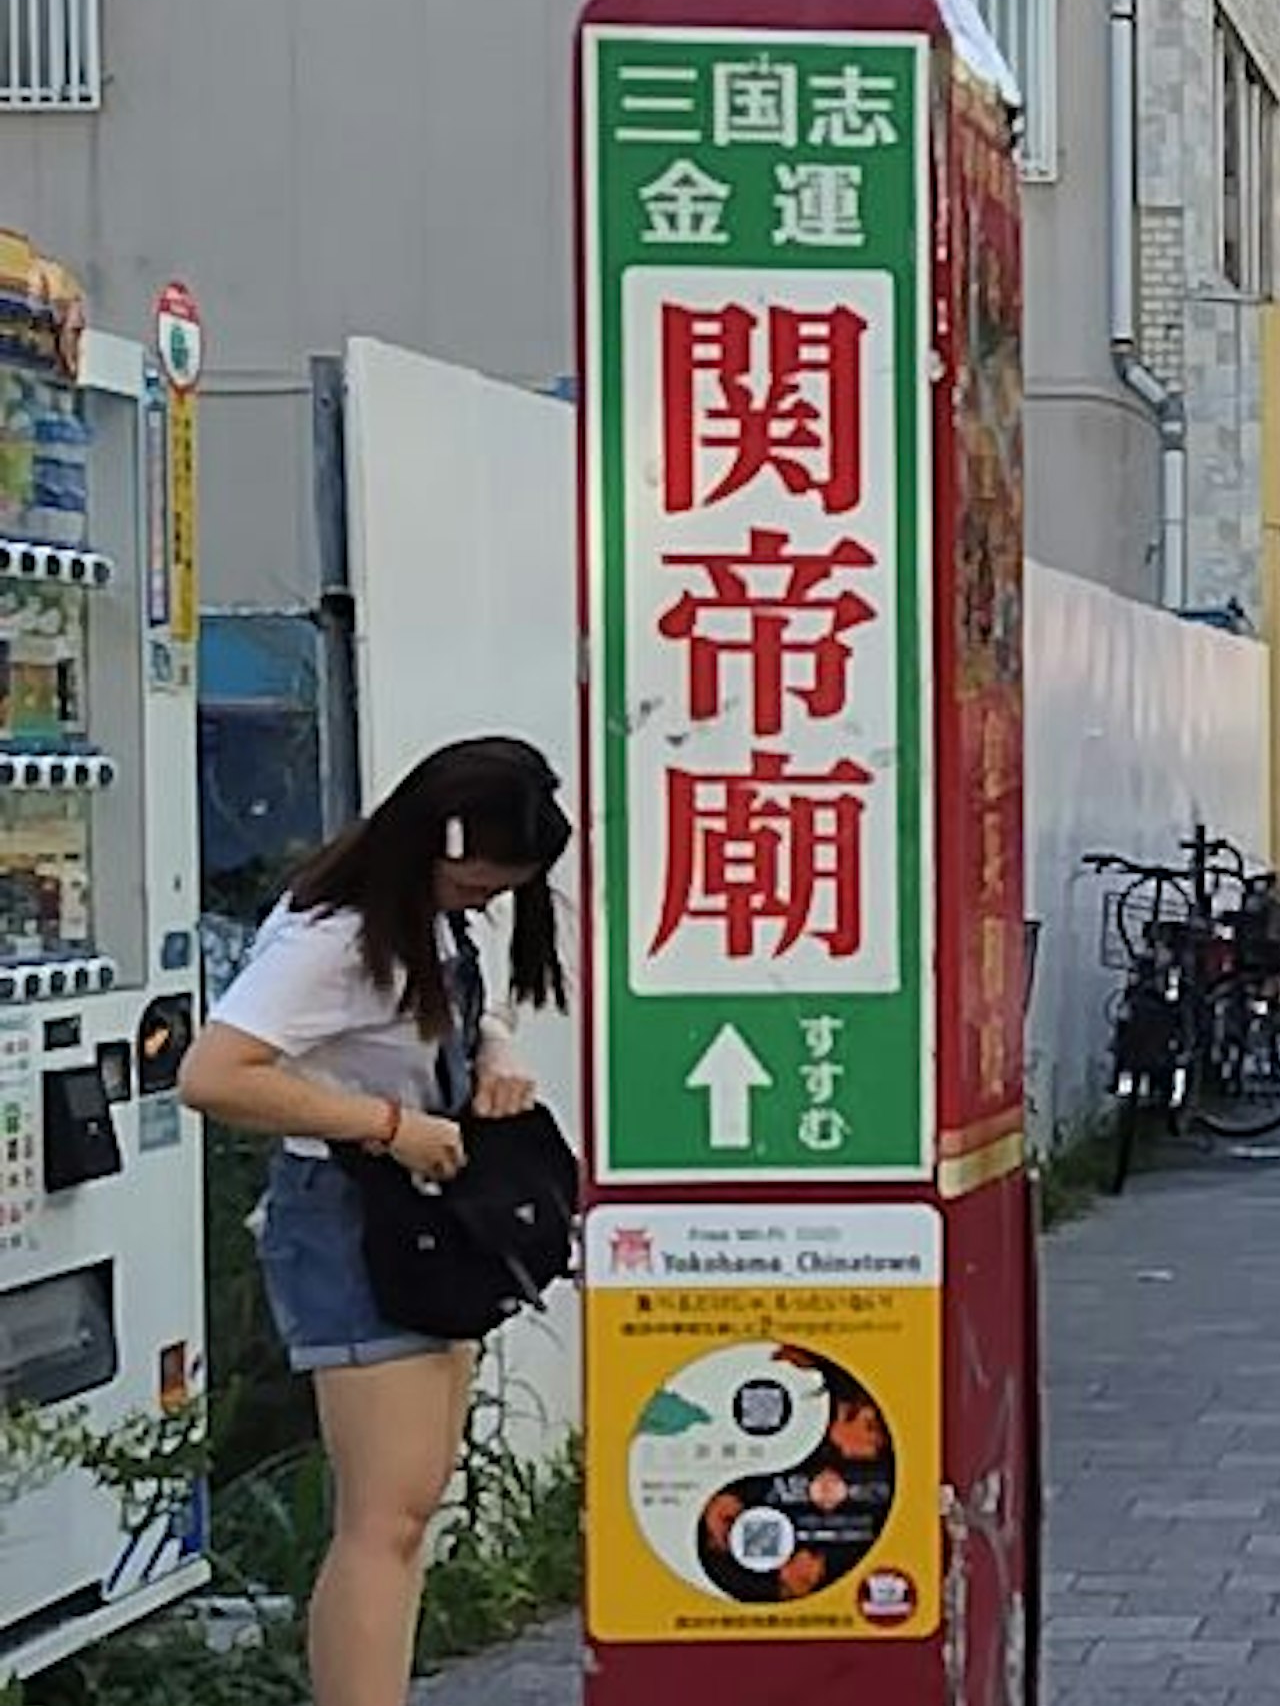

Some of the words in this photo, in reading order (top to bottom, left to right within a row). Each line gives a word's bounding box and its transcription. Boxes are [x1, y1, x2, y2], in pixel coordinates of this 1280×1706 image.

[615, 55, 899, 148] 三国志
[639, 158, 866, 248] 金運
[646, 301, 878, 960] 関帝廟
[798, 1014, 849, 1153] すすむ
